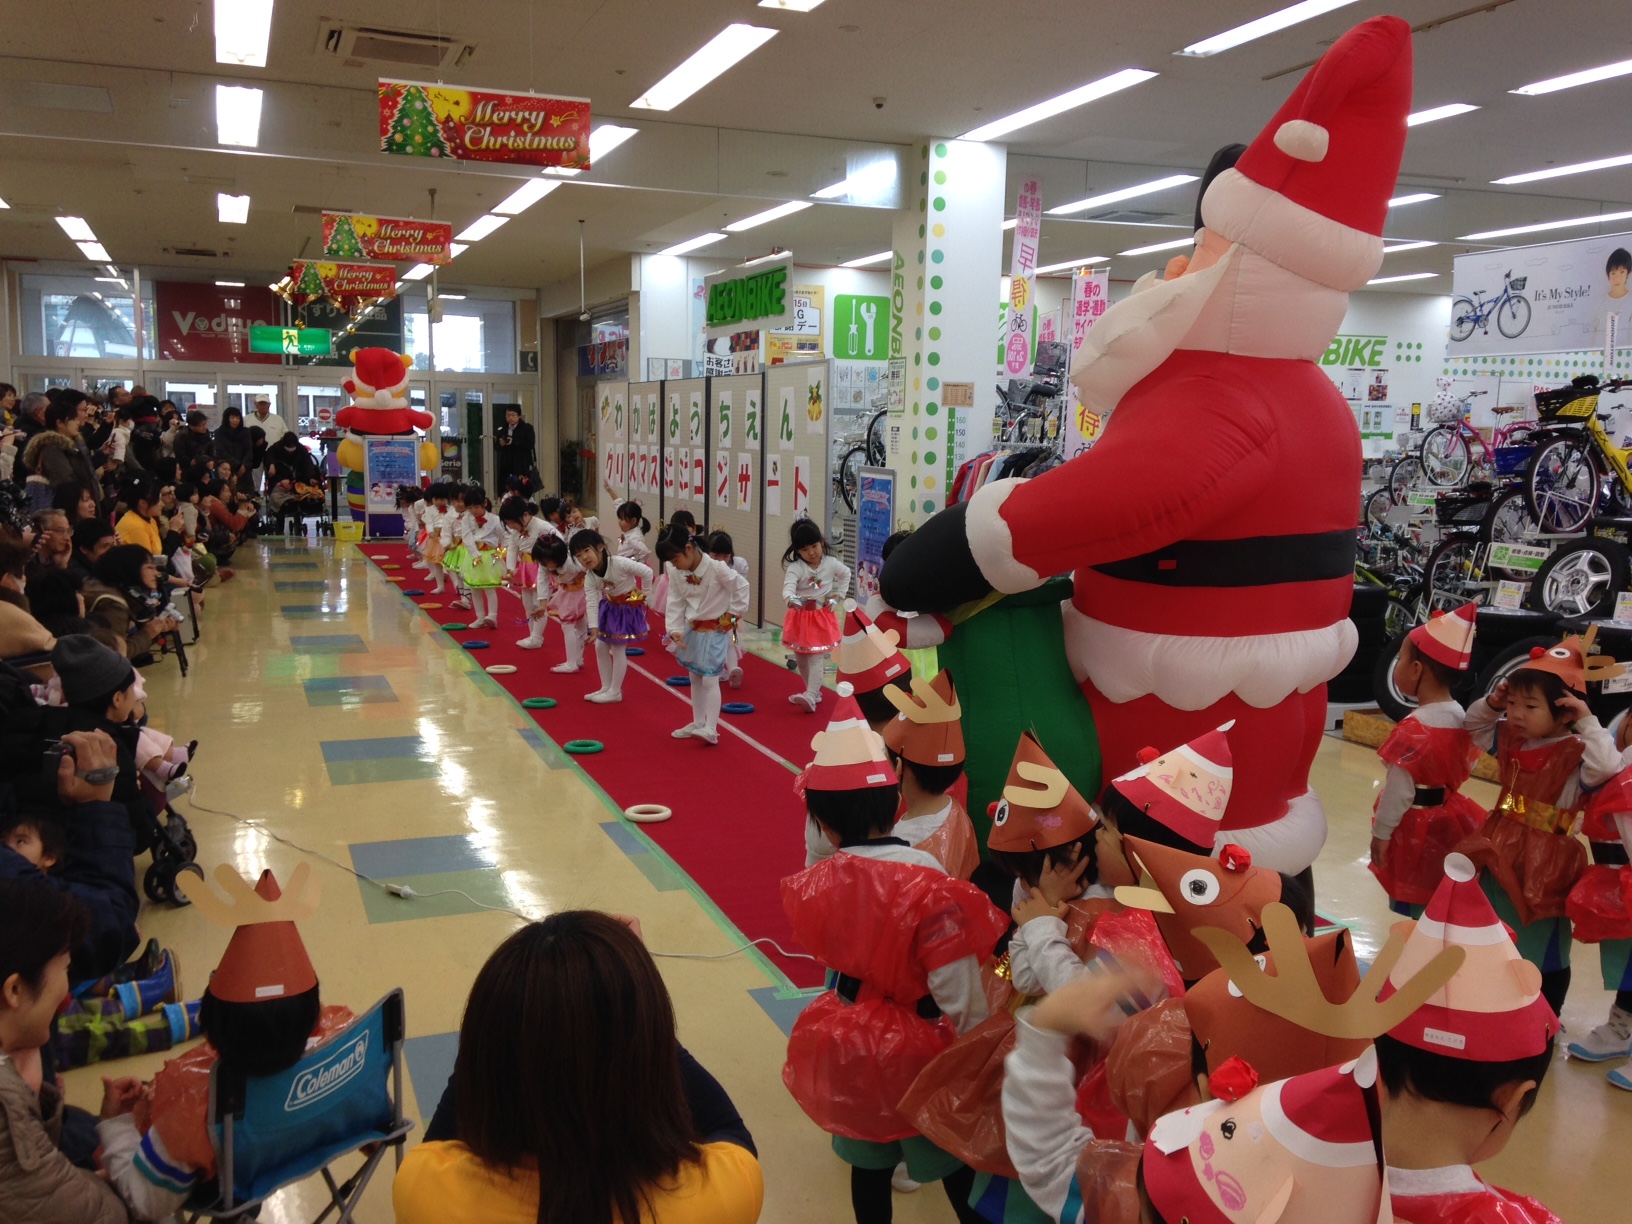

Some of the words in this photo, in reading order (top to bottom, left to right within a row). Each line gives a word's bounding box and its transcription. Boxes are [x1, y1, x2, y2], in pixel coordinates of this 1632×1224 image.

[460, 100, 547, 133] Merry
[464, 124, 576, 151] Christmas
[372, 223, 424, 244] Merry
[374, 239, 443, 255] Christmas
[334, 279, 389, 291] Christmas
[335, 268, 374, 282] Merry
[706, 270, 787, 323] AEONBIKE
[1084, 281, 1101, 298] 春の
[1534, 290, 1547, 302] It's
[1549, 288, 1563, 302] My
[1564, 285, 1591, 301] Style!
[892, 249, 906, 359] AEONB
[1075, 318, 1097, 334] サイク
[1315, 337, 1387, 366] BIKE
[615, 398, 793, 442] わかばようちえん
[296, 1052, 356, 1098] Coleman
